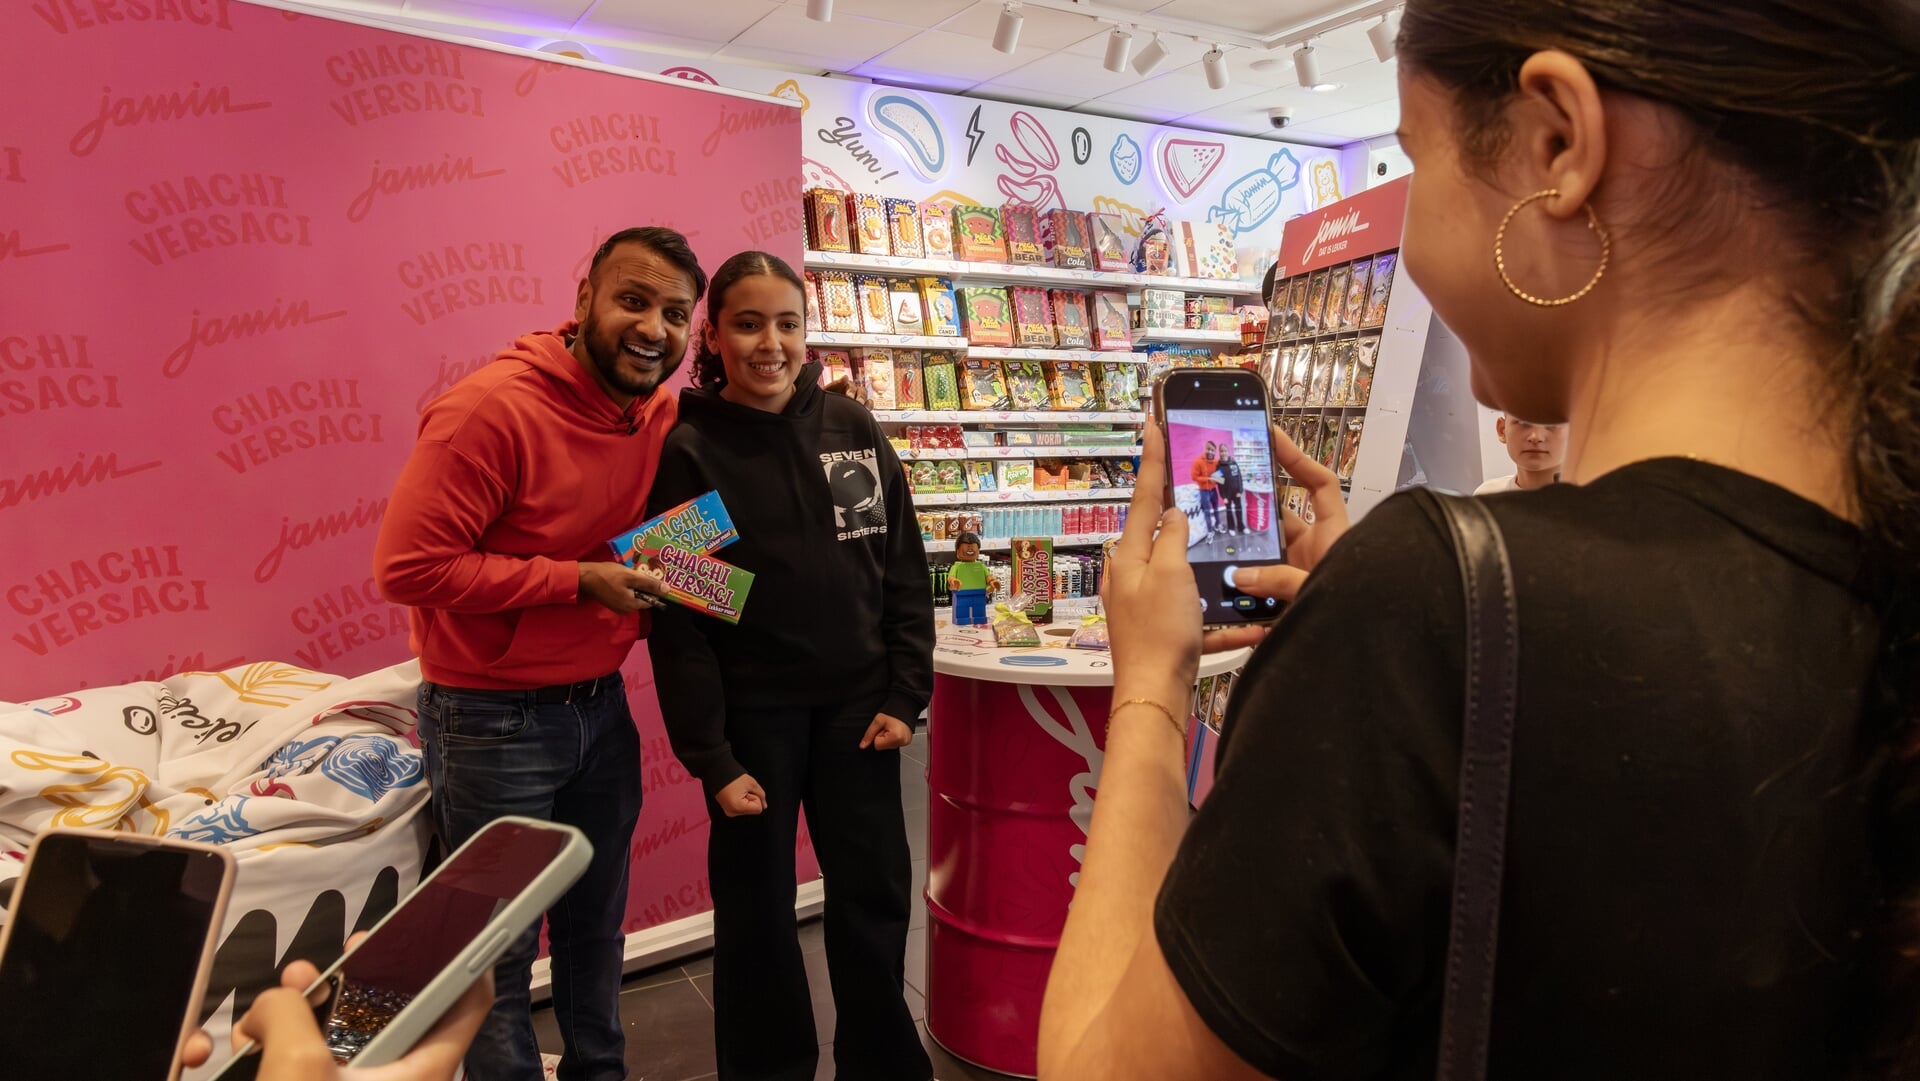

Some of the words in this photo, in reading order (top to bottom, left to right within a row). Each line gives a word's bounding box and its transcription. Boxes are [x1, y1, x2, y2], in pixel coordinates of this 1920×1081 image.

[325, 44, 465, 87] CHACHI
[69, 81, 272, 157] jamin
[329, 80, 486, 126] VERSACI
[549, 113, 662, 154] CHACHI
[347, 153, 506, 223] jamin
[552, 145, 677, 189] VERSACI
[124, 173, 289, 225] CHACHI
[128, 211, 313, 266] VERSACI
[1015, 253, 1042, 262] BEAR
[1302, 207, 1369, 265] jamin
[399, 242, 525, 290] CHACHI
[1066, 257, 1086, 266] Cola
[402, 275, 544, 325] VERSACI
[0, 334, 93, 372] CHI
[163, 298, 347, 378] jamin
[1023, 334, 1051, 343] BEAR
[1066, 336, 1084, 346] Cola
[0, 374, 122, 417] SACI
[212, 379, 362, 436] CHACHI
[216, 413, 384, 474] VERSACI
[819, 448, 877, 462] SEVEN
[1035, 433, 1062, 445] WORM
[0, 452, 162, 510] amin
[837, 525, 888, 541] SISTERS
[6, 545, 183, 616] CHACHI
[659, 544, 732, 587] CHACHI
[663, 566, 735, 608] VERSACI
[1035, 551, 1050, 604] CHACHI
[1061, 570, 1069, 595] PRIME
[1071, 569, 1081, 594] PRIME
[12, 580, 209, 656] VERSACI
[290, 577, 387, 635] CHAC
[294, 606, 411, 669] VERSA
